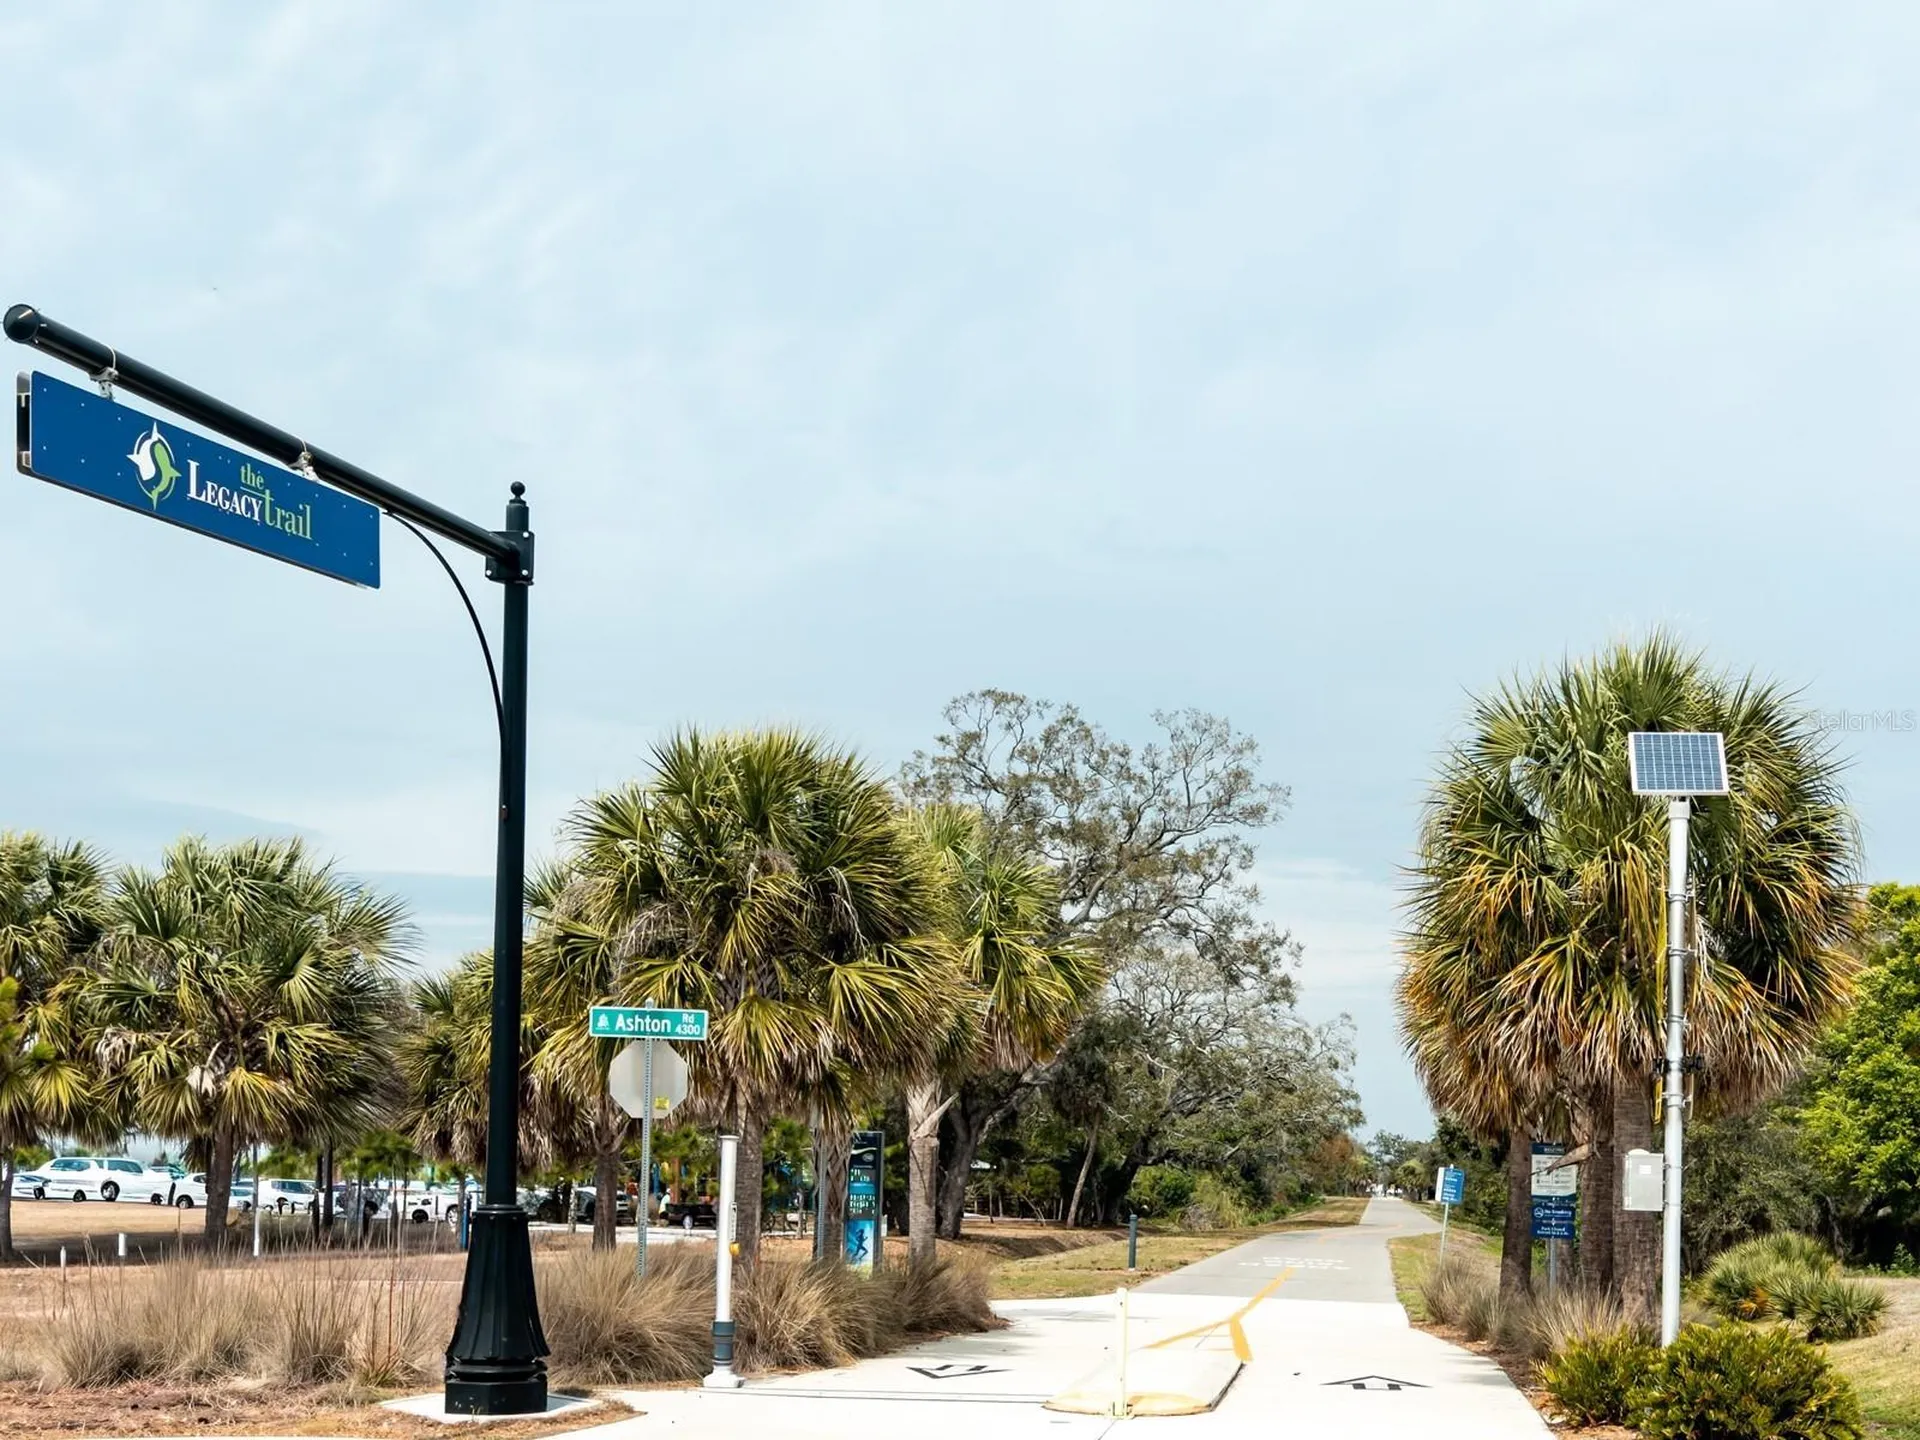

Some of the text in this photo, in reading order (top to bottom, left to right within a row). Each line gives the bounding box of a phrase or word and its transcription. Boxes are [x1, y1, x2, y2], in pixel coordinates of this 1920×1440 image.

[240, 463, 265, 490] the
[264, 488, 313, 540] trail
[615, 1013, 695, 1033] Ashton Rd
[675, 1024, 700, 1035] 4300
